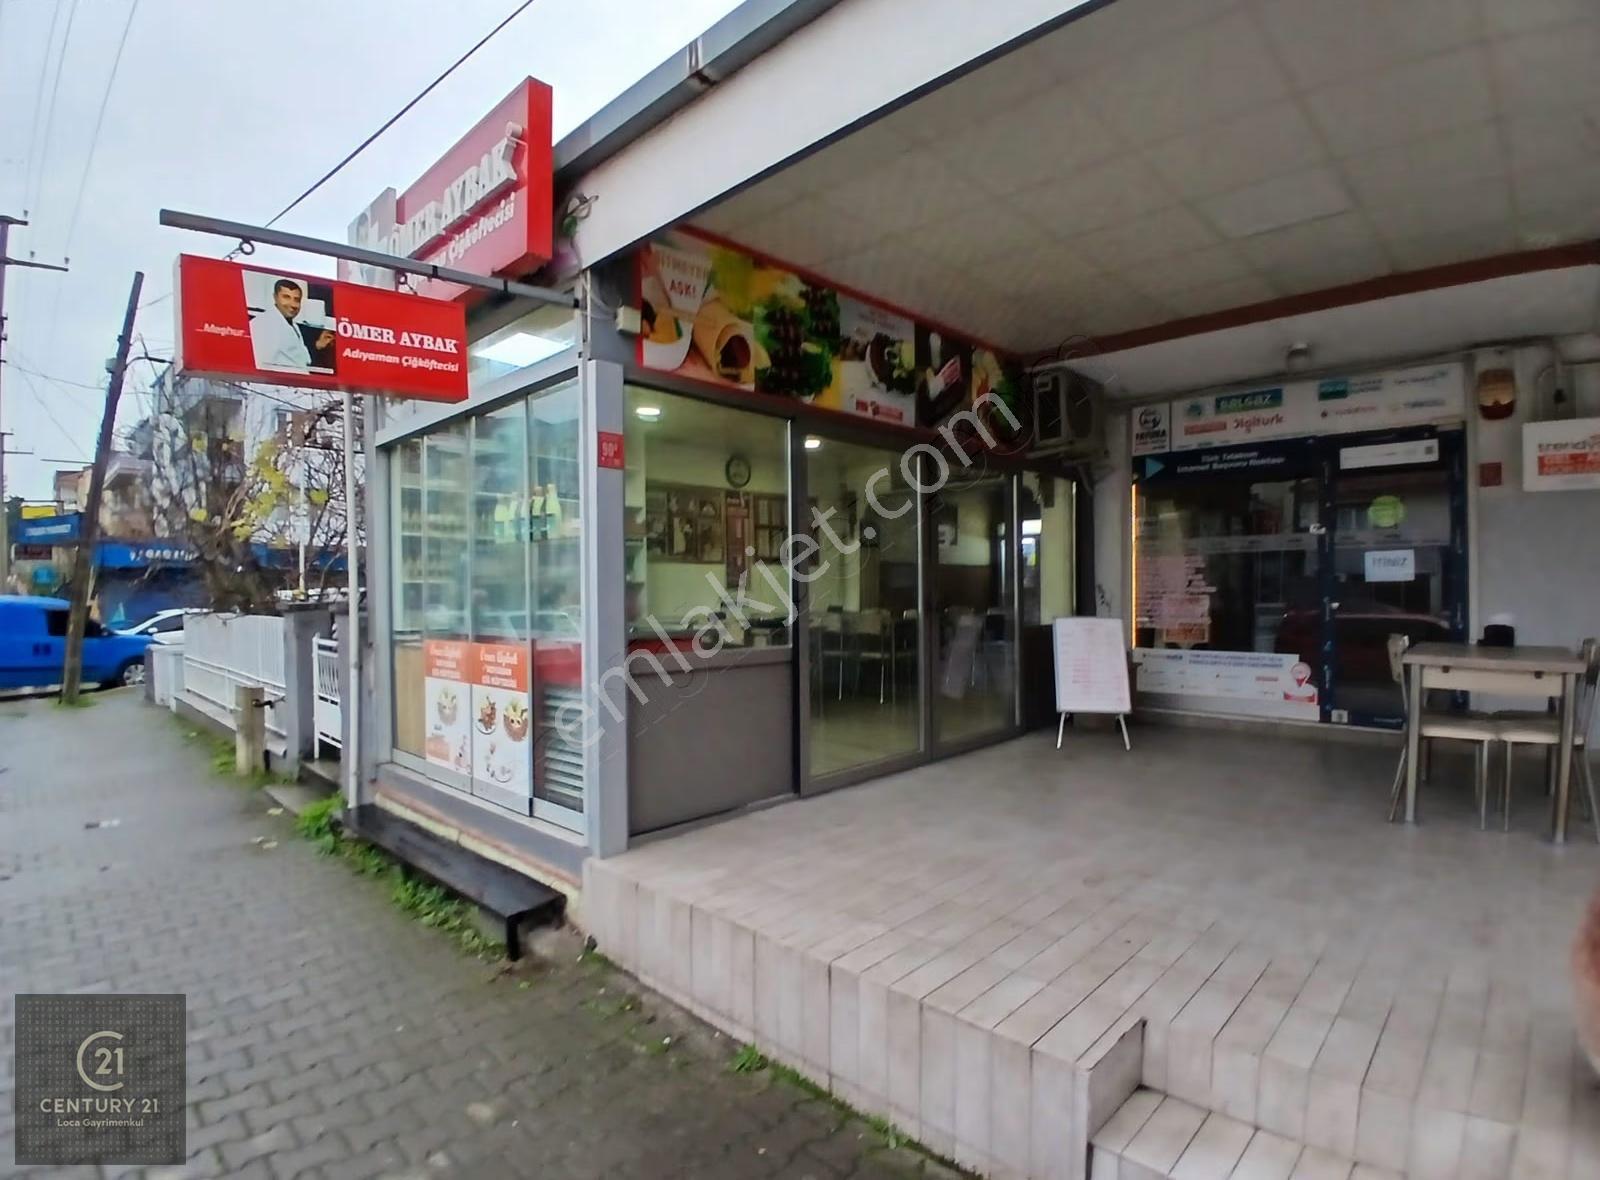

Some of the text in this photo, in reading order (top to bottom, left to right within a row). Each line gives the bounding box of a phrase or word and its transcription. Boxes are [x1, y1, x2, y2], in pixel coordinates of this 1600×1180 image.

[440, 137, 518, 230] AYBAK
[338, 317, 459, 354] ÖMER AYBAK
[342, 347, 460, 372] Adıyaman Çiğköftecisi
